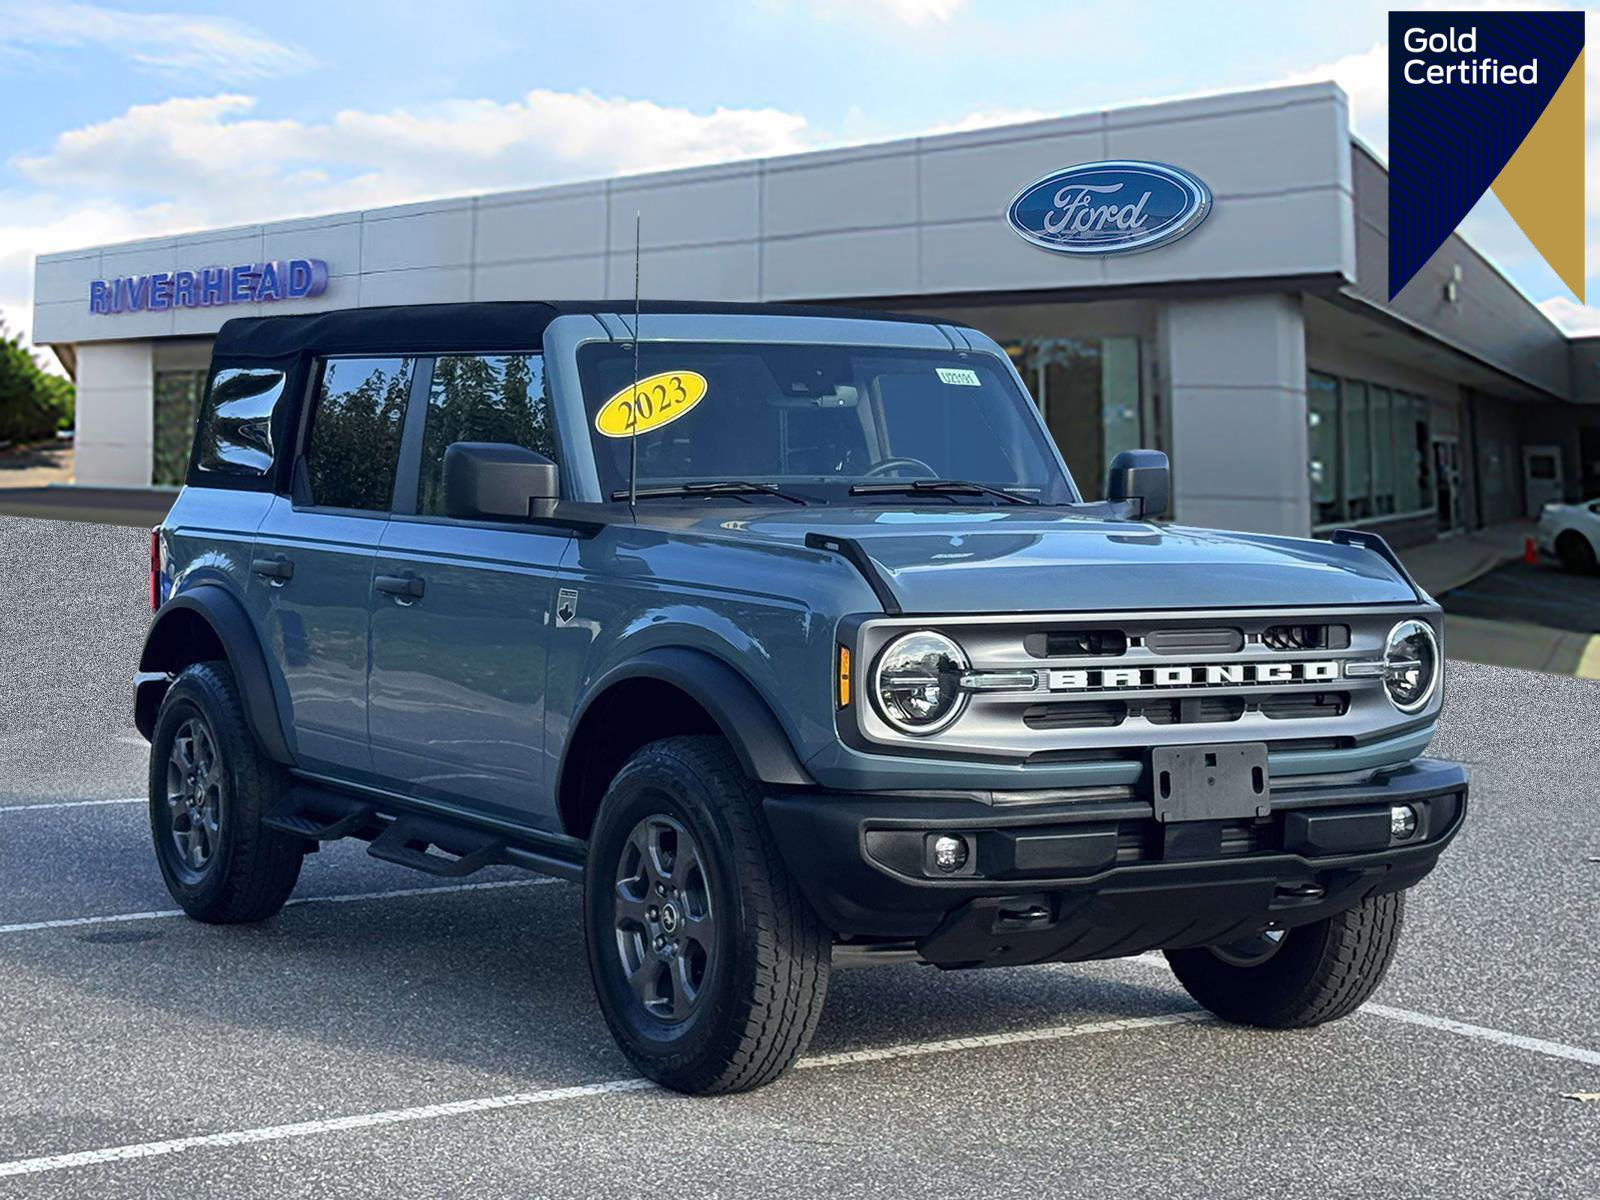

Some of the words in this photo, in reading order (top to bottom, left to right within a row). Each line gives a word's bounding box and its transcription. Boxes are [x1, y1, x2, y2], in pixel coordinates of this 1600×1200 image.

[1044, 183, 1152, 233] Ford
[90, 259, 320, 314] RIVERHEAD
[618, 377, 687, 430] 2023
[1049, 661, 1338, 689] BRONCO
